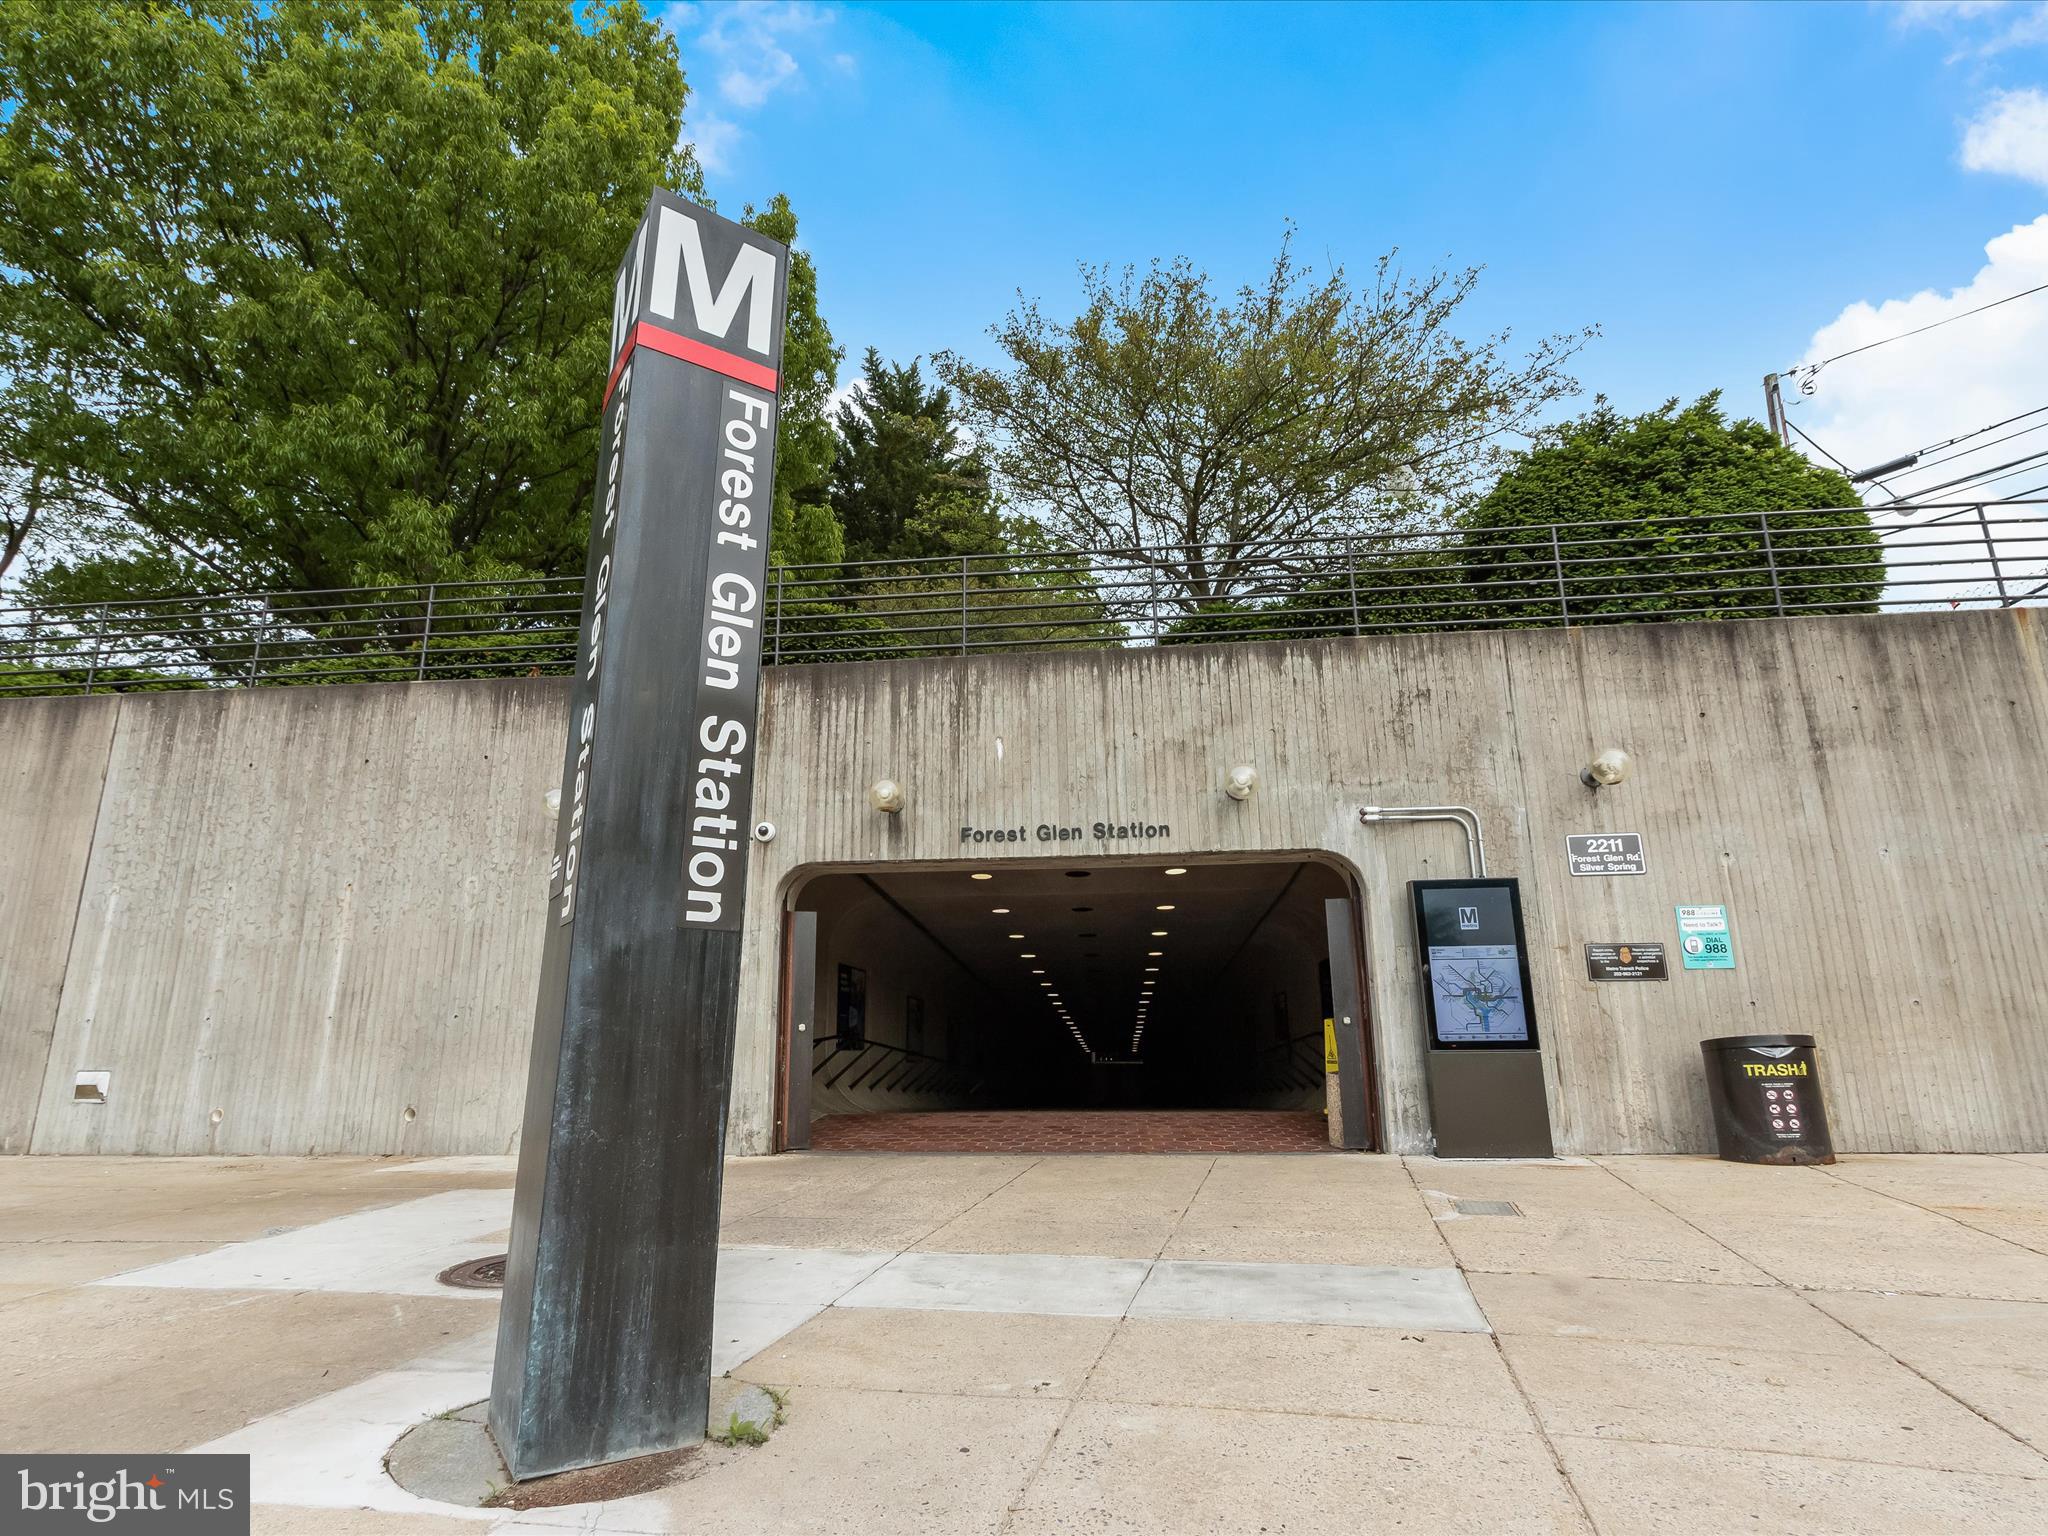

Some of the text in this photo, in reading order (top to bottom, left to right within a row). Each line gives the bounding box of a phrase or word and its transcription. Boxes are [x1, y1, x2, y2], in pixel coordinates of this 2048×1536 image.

[650, 205, 777, 356] M
[609, 216, 649, 373] M
[561, 363, 632, 919] Forest Glen Station
[685, 389, 770, 924] Forest Glen Station
[960, 822, 1170, 843] Forest Glen Station
[1586, 838, 1624, 853] 2211
[1572, 853, 1641, 863] Forest Glen Rd.
[1580, 862, 1637, 872] Silver Spring
[1460, 908, 1478, 924] M
[1704, 943, 1728, 954] 988
[1743, 1063, 1799, 1077] TRASH
